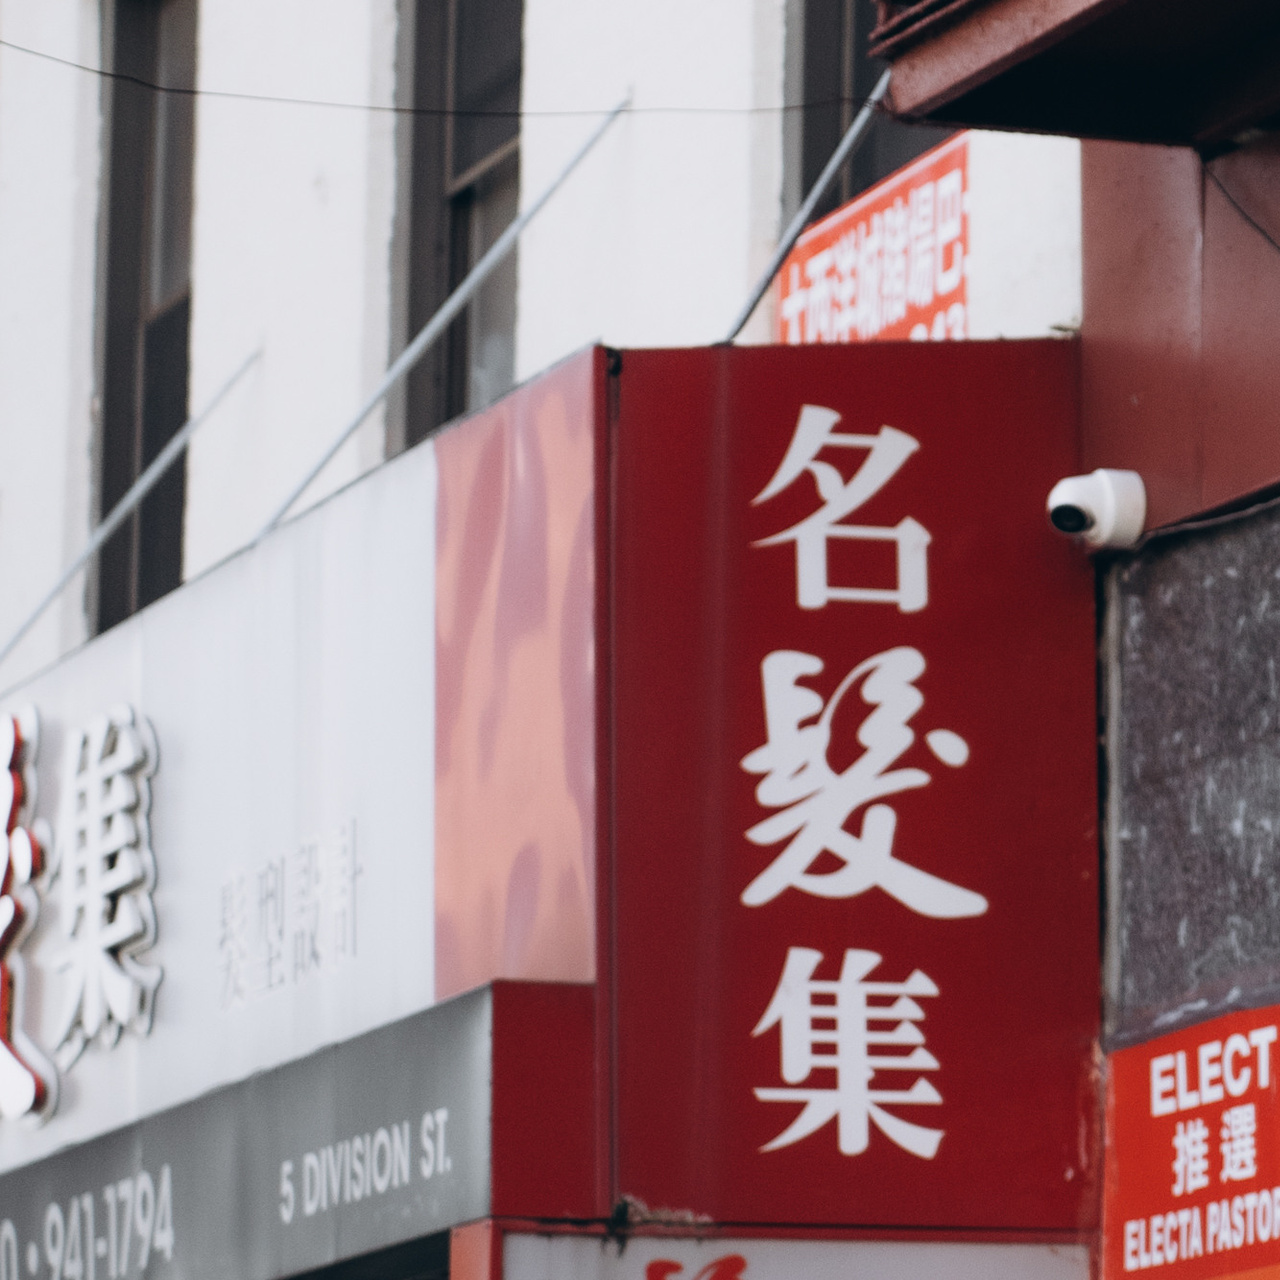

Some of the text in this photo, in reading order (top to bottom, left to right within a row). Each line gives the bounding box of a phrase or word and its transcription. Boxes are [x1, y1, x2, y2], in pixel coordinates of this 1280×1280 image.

[740, 403, 988, 1160] 名髮集
[1150, 1024, 1278, 1118] ELECT
[279, 1107, 452, 1224] 5 DIVISION ST.
[1171, 1102, 1257, 1197] 推選
[1123, 1205, 1202, 1273] ELECTA
